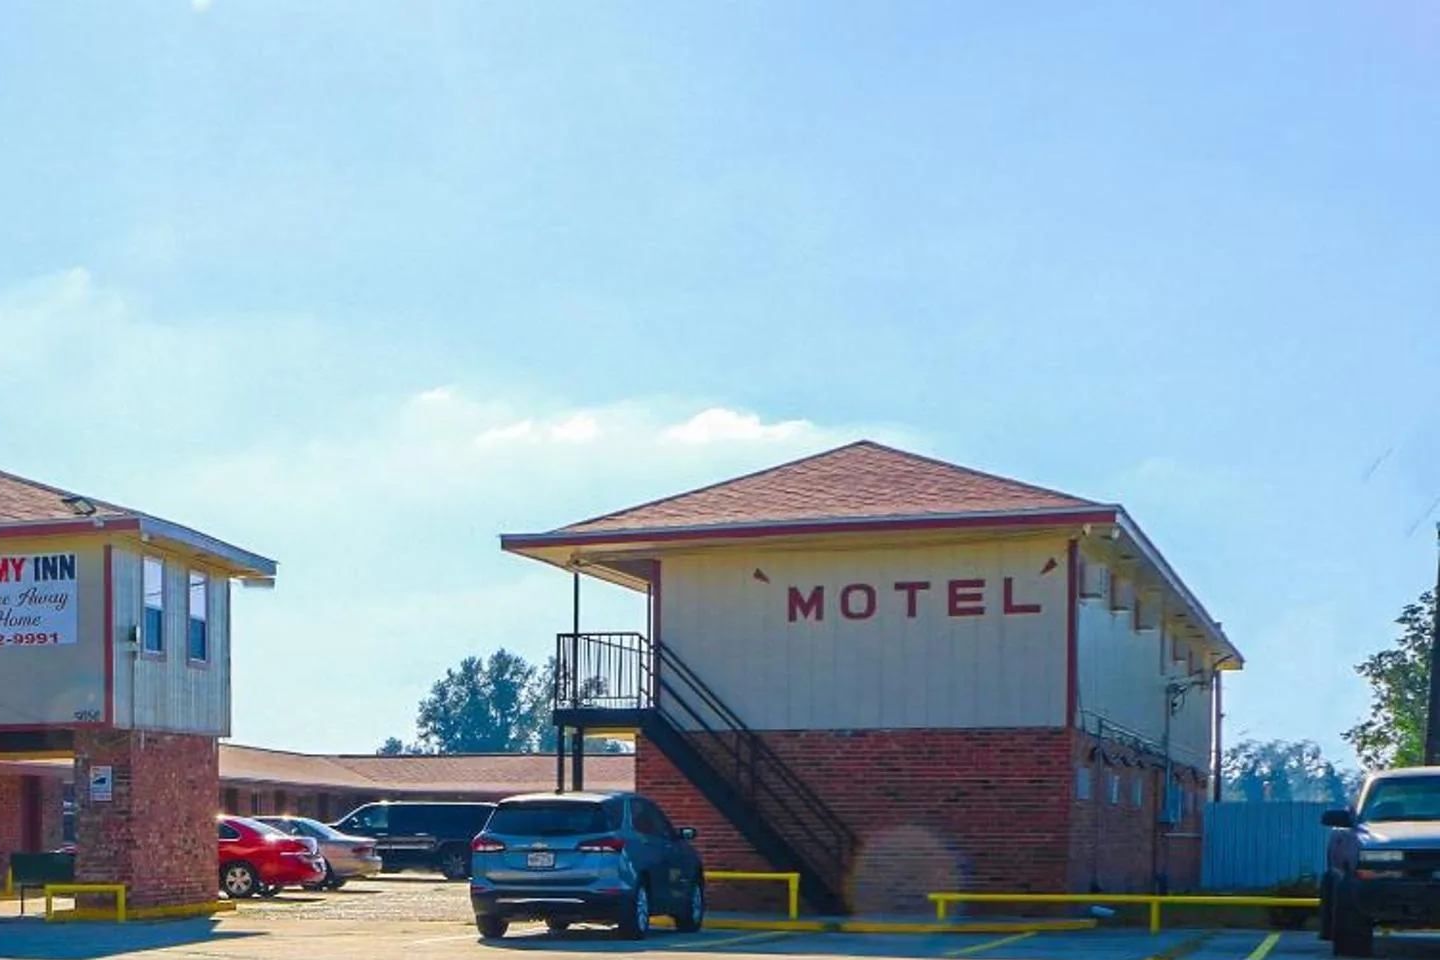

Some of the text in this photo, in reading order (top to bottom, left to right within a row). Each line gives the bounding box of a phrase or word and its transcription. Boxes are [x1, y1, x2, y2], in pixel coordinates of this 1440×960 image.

[33, 554, 76, 582] INN
[13, 587, 70, 612] Away
[787, 576, 1042, 622] MOTEL
